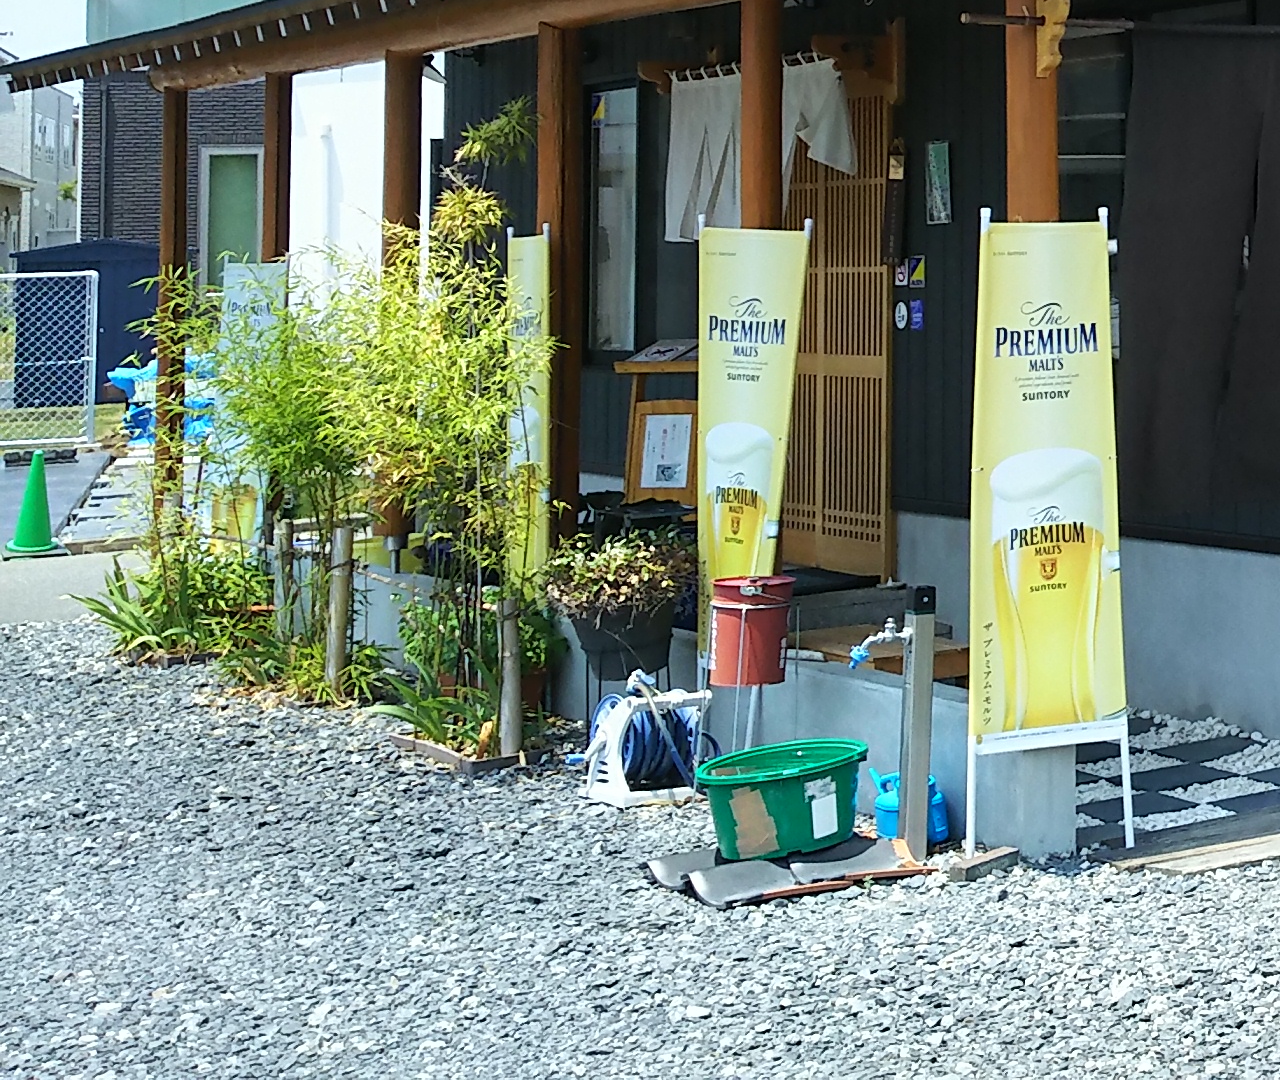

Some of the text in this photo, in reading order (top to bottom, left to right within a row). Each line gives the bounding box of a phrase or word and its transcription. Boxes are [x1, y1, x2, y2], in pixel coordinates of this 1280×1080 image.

[728, 296, 768, 319] The
[1020, 301, 1071, 327] The
[708, 315, 787, 346] PREMIUM
[994, 322, 1099, 358] PREMIUM
[732, 344, 759, 358] MALT'S
[1028, 355, 1064, 373] MALT'S
[726, 372, 761, 383] SUNTORY
[1022, 389, 1071, 402] SUNTORY
[715, 486, 758, 510] PREMIUM
[1027, 505, 1067, 524] The
[1009, 521, 1086, 551] PREMIUM
[1034, 544, 1063, 557] MALT'S
[1029, 582, 1068, 593] SUNTORY
